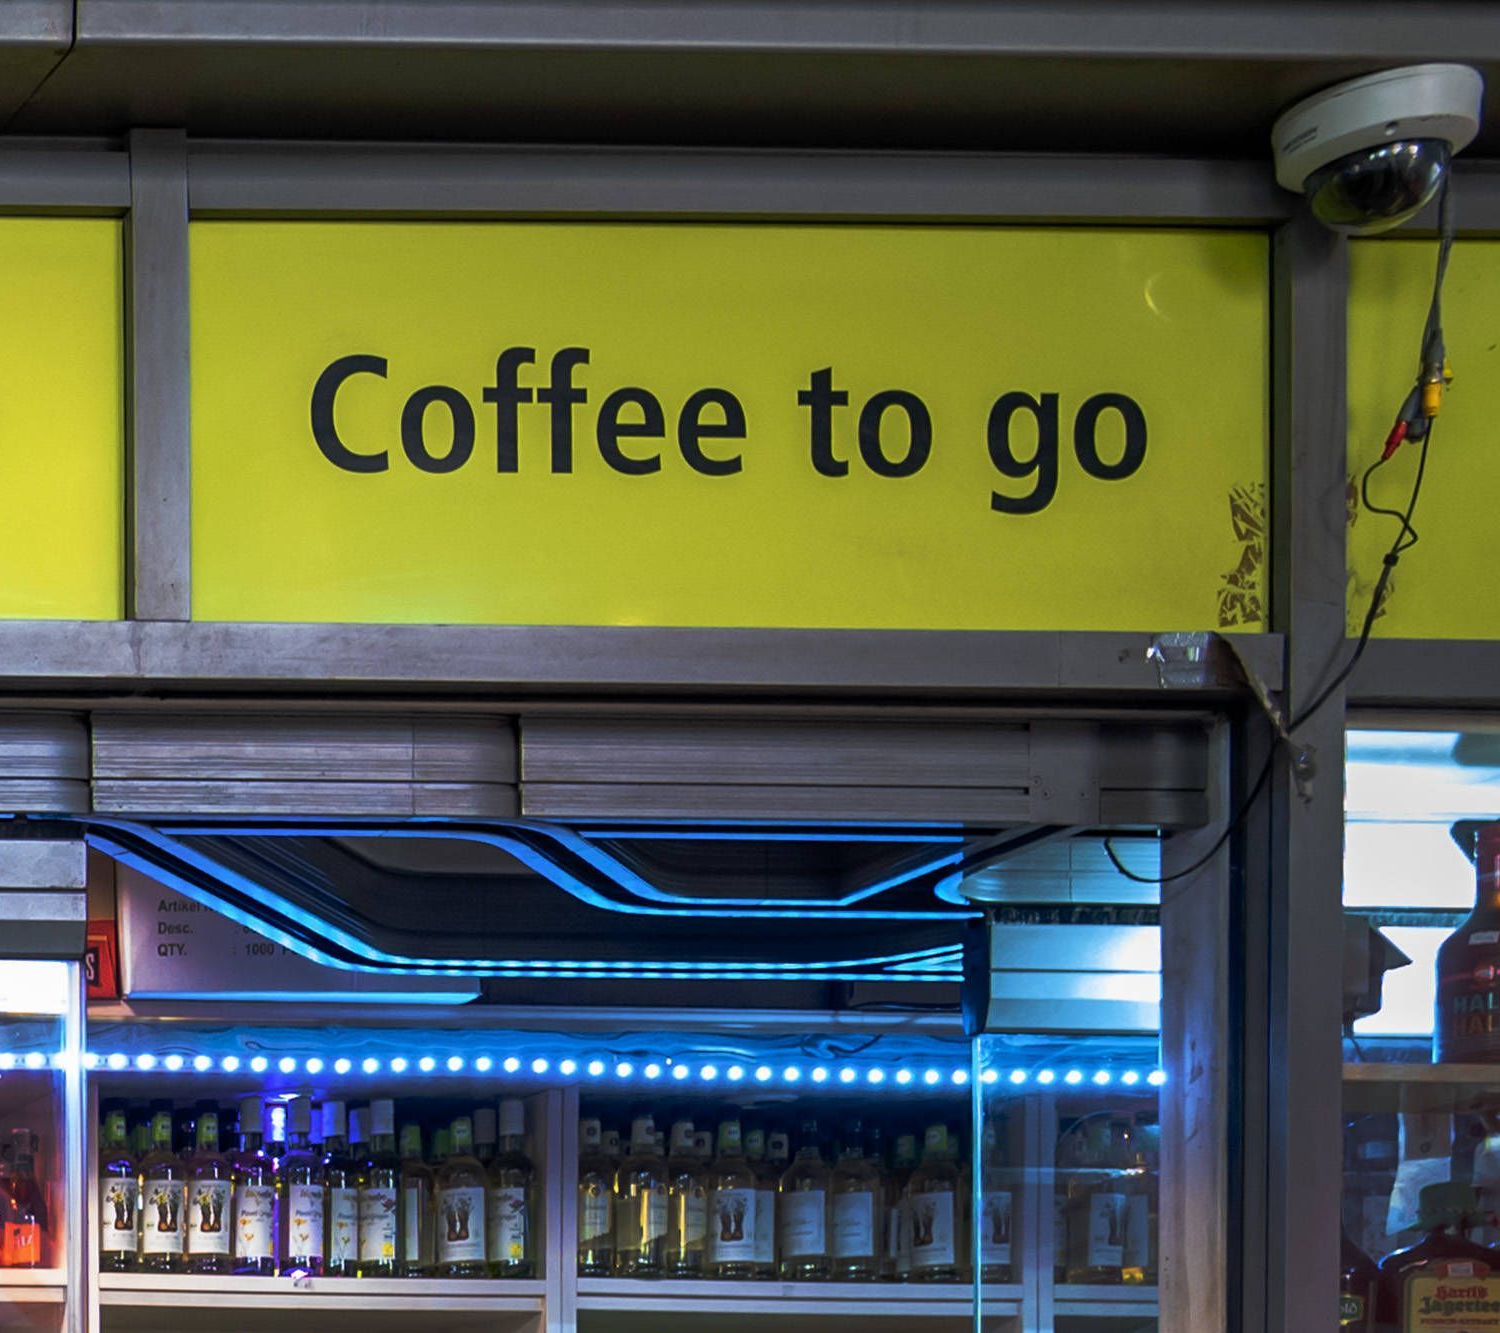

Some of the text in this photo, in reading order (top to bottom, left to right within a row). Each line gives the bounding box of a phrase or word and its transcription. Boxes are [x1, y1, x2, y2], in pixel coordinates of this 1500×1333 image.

[310, 346, 1148, 517] Coffee to go
